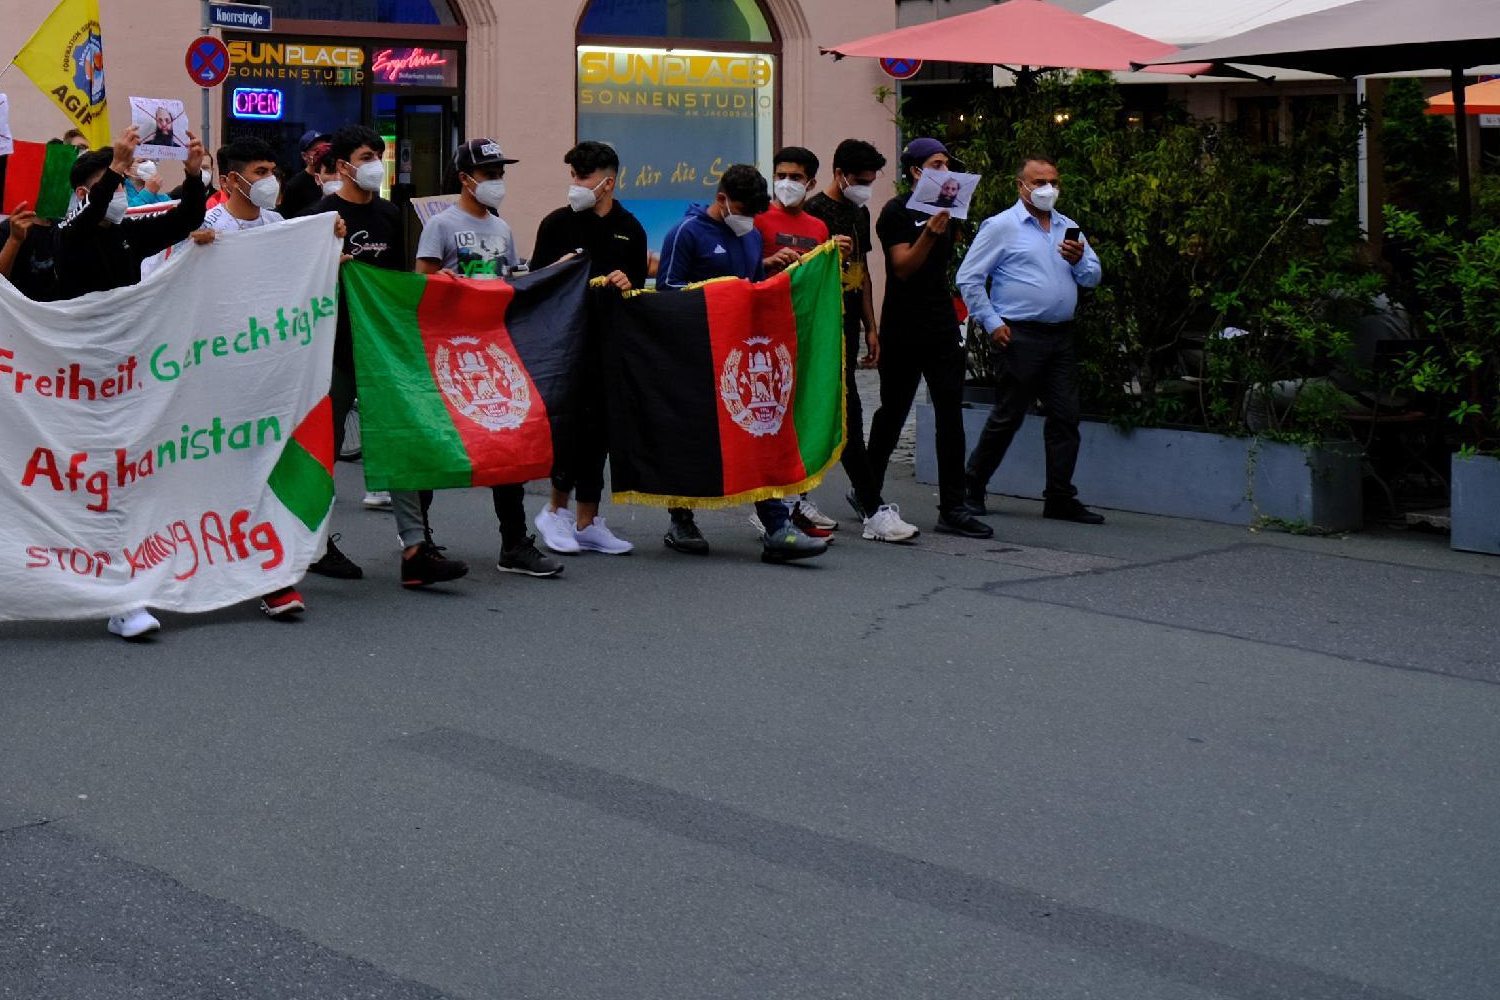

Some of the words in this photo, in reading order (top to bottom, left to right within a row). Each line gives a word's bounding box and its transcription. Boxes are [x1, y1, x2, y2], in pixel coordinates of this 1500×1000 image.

[216, 8, 263, 27] Knorrstraße
[228, 40, 366, 67] SUNPLACE
[228, 65, 365, 85] SONNENSTUDIO
[580, 51, 771, 89] SUNPLACE
[235, 92, 279, 114] OPEN
[580, 89, 772, 109] SONNENSTUDIO
[635, 163, 662, 187] dir
[670, 160, 696, 184] die
[21, 415, 282, 513] Afghanistan
[25, 545, 112, 578] STOP
[199, 508, 285, 572] Afg
